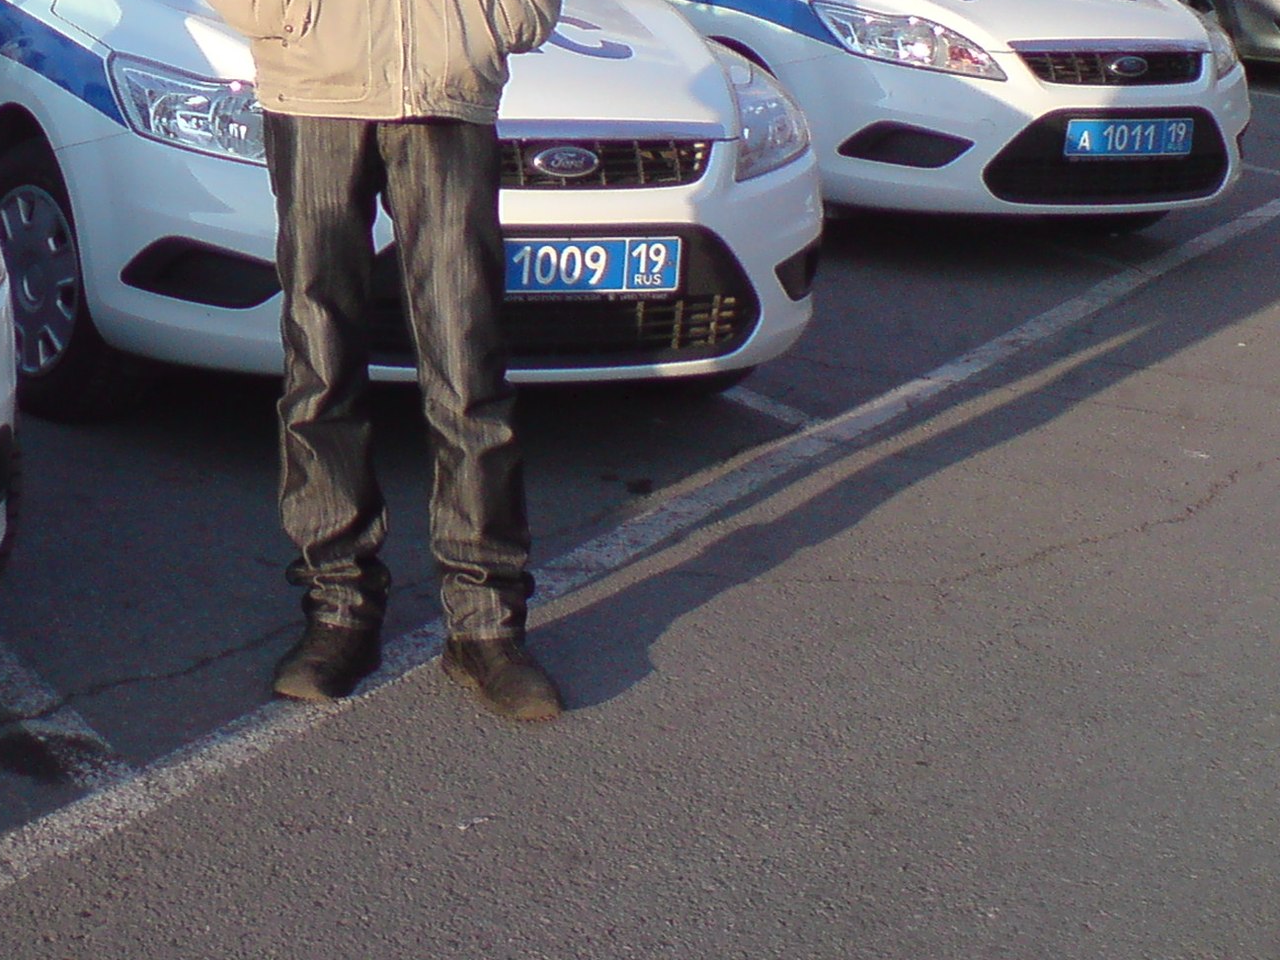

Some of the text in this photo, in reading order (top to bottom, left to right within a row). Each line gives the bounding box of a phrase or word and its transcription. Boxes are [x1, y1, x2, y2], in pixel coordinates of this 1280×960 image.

[1077, 122, 1187, 151] А 1011 19
[549, 151, 585, 168] Ford
[512, 243, 667, 285] 1009 19
[634, 273, 662, 285] RUS
